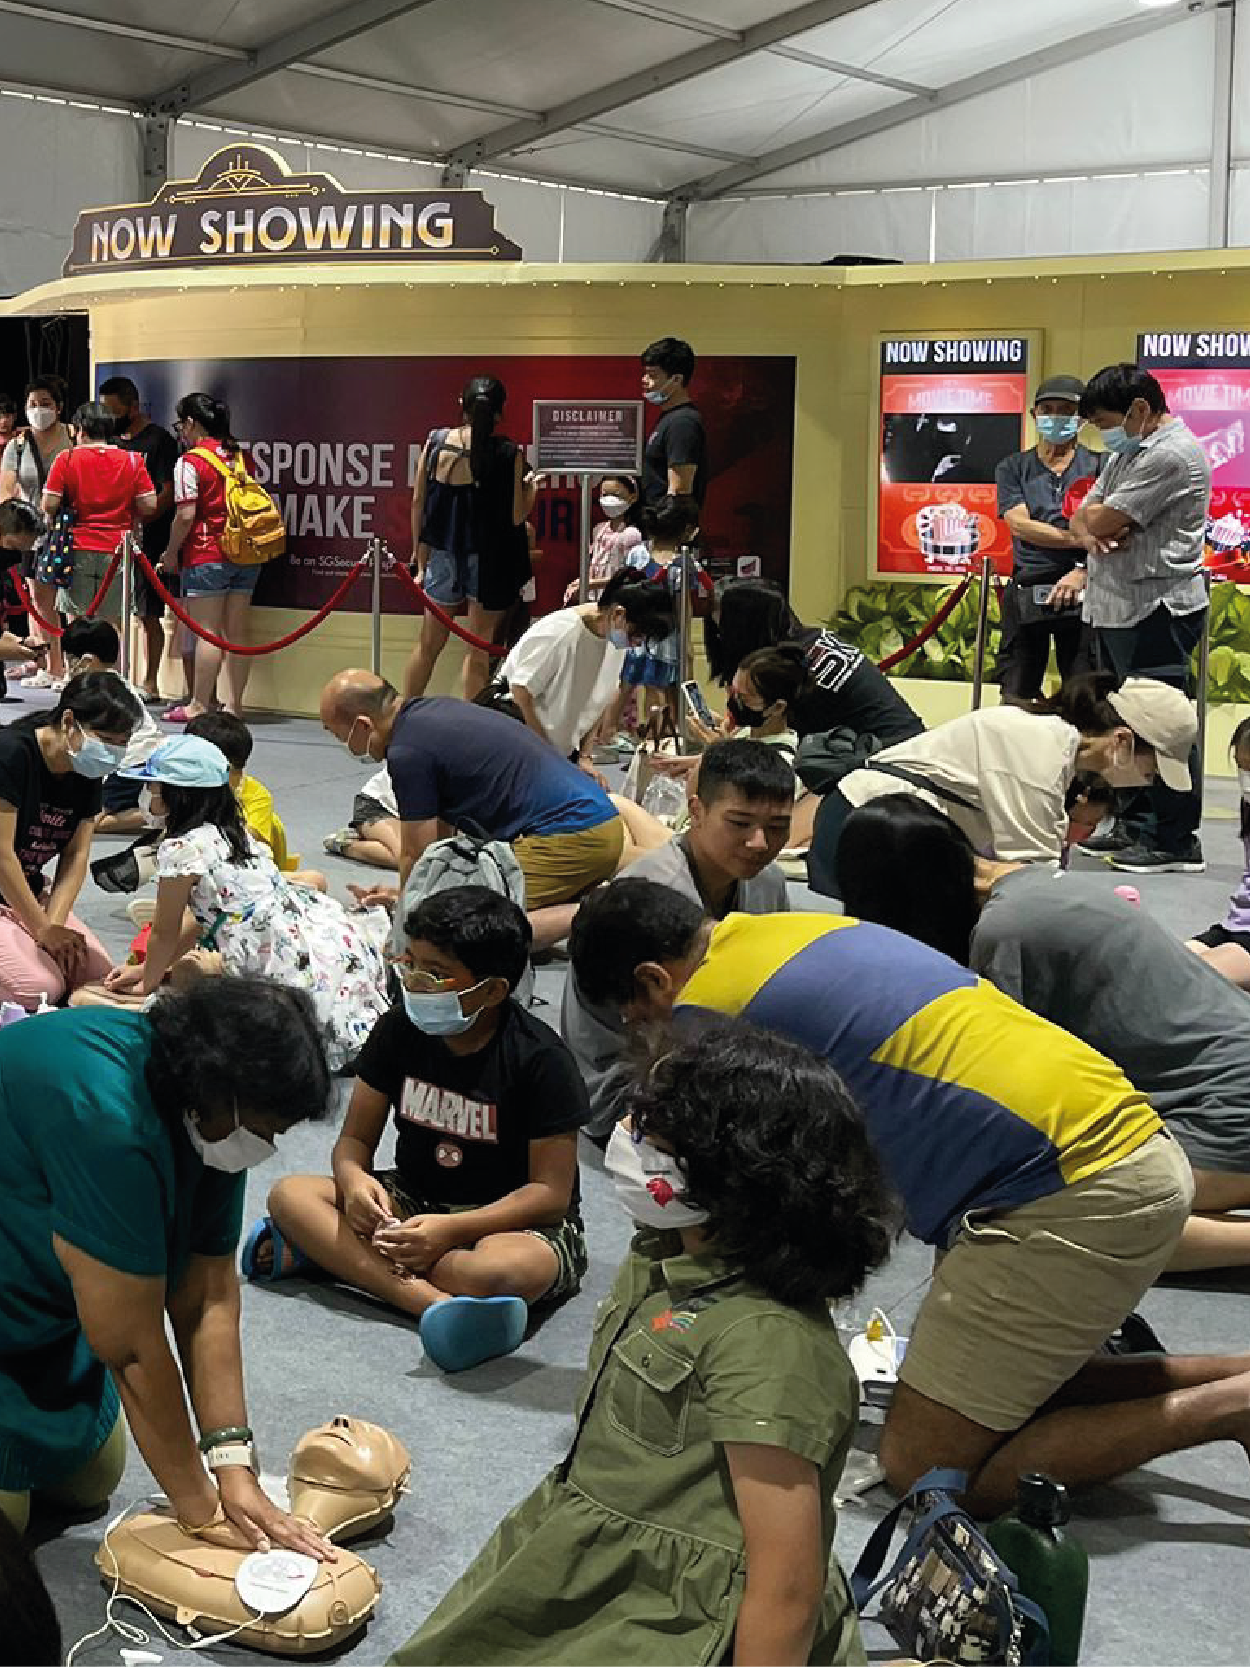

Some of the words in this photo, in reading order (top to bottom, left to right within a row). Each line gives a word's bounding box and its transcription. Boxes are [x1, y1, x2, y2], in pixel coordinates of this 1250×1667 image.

[90, 213, 177, 262] NOW
[199, 202, 454, 254] SHOWING
[885, 342, 928, 363] NOW
[933, 340, 1022, 363] SHOWING
[1143, 334, 1191, 357] NOW
[552, 410, 624, 422] DISCLAIMER
[237, 440, 395, 488] SPONSE
[400, 1076, 498, 1143] MARVEL
